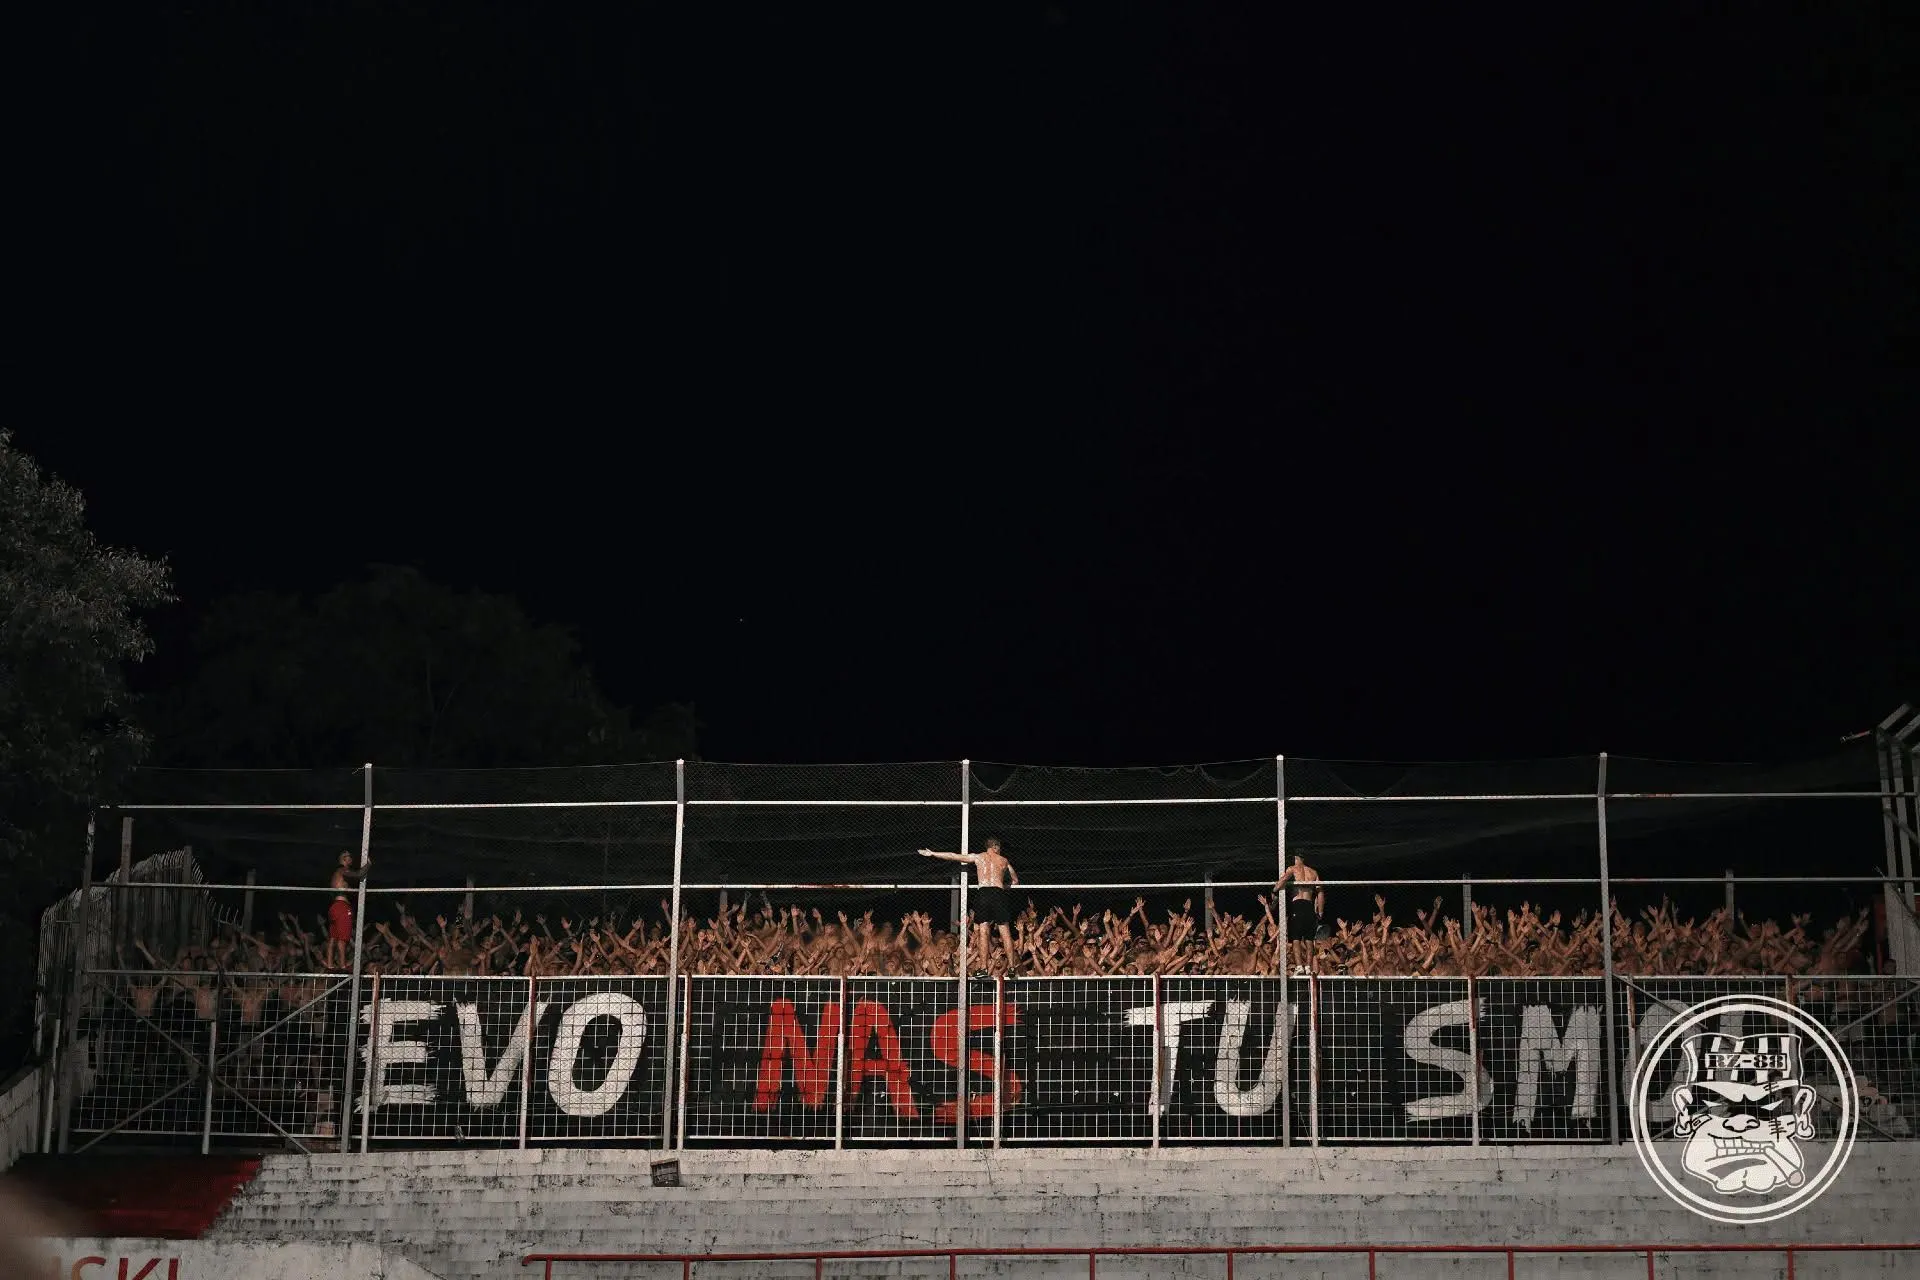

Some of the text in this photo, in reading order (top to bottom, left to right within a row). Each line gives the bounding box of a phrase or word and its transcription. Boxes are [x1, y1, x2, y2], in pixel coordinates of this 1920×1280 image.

[353, 992, 648, 1117] EVO
[751, 995, 1025, 1124] NAS
[1122, 997, 1298, 1118] TU
